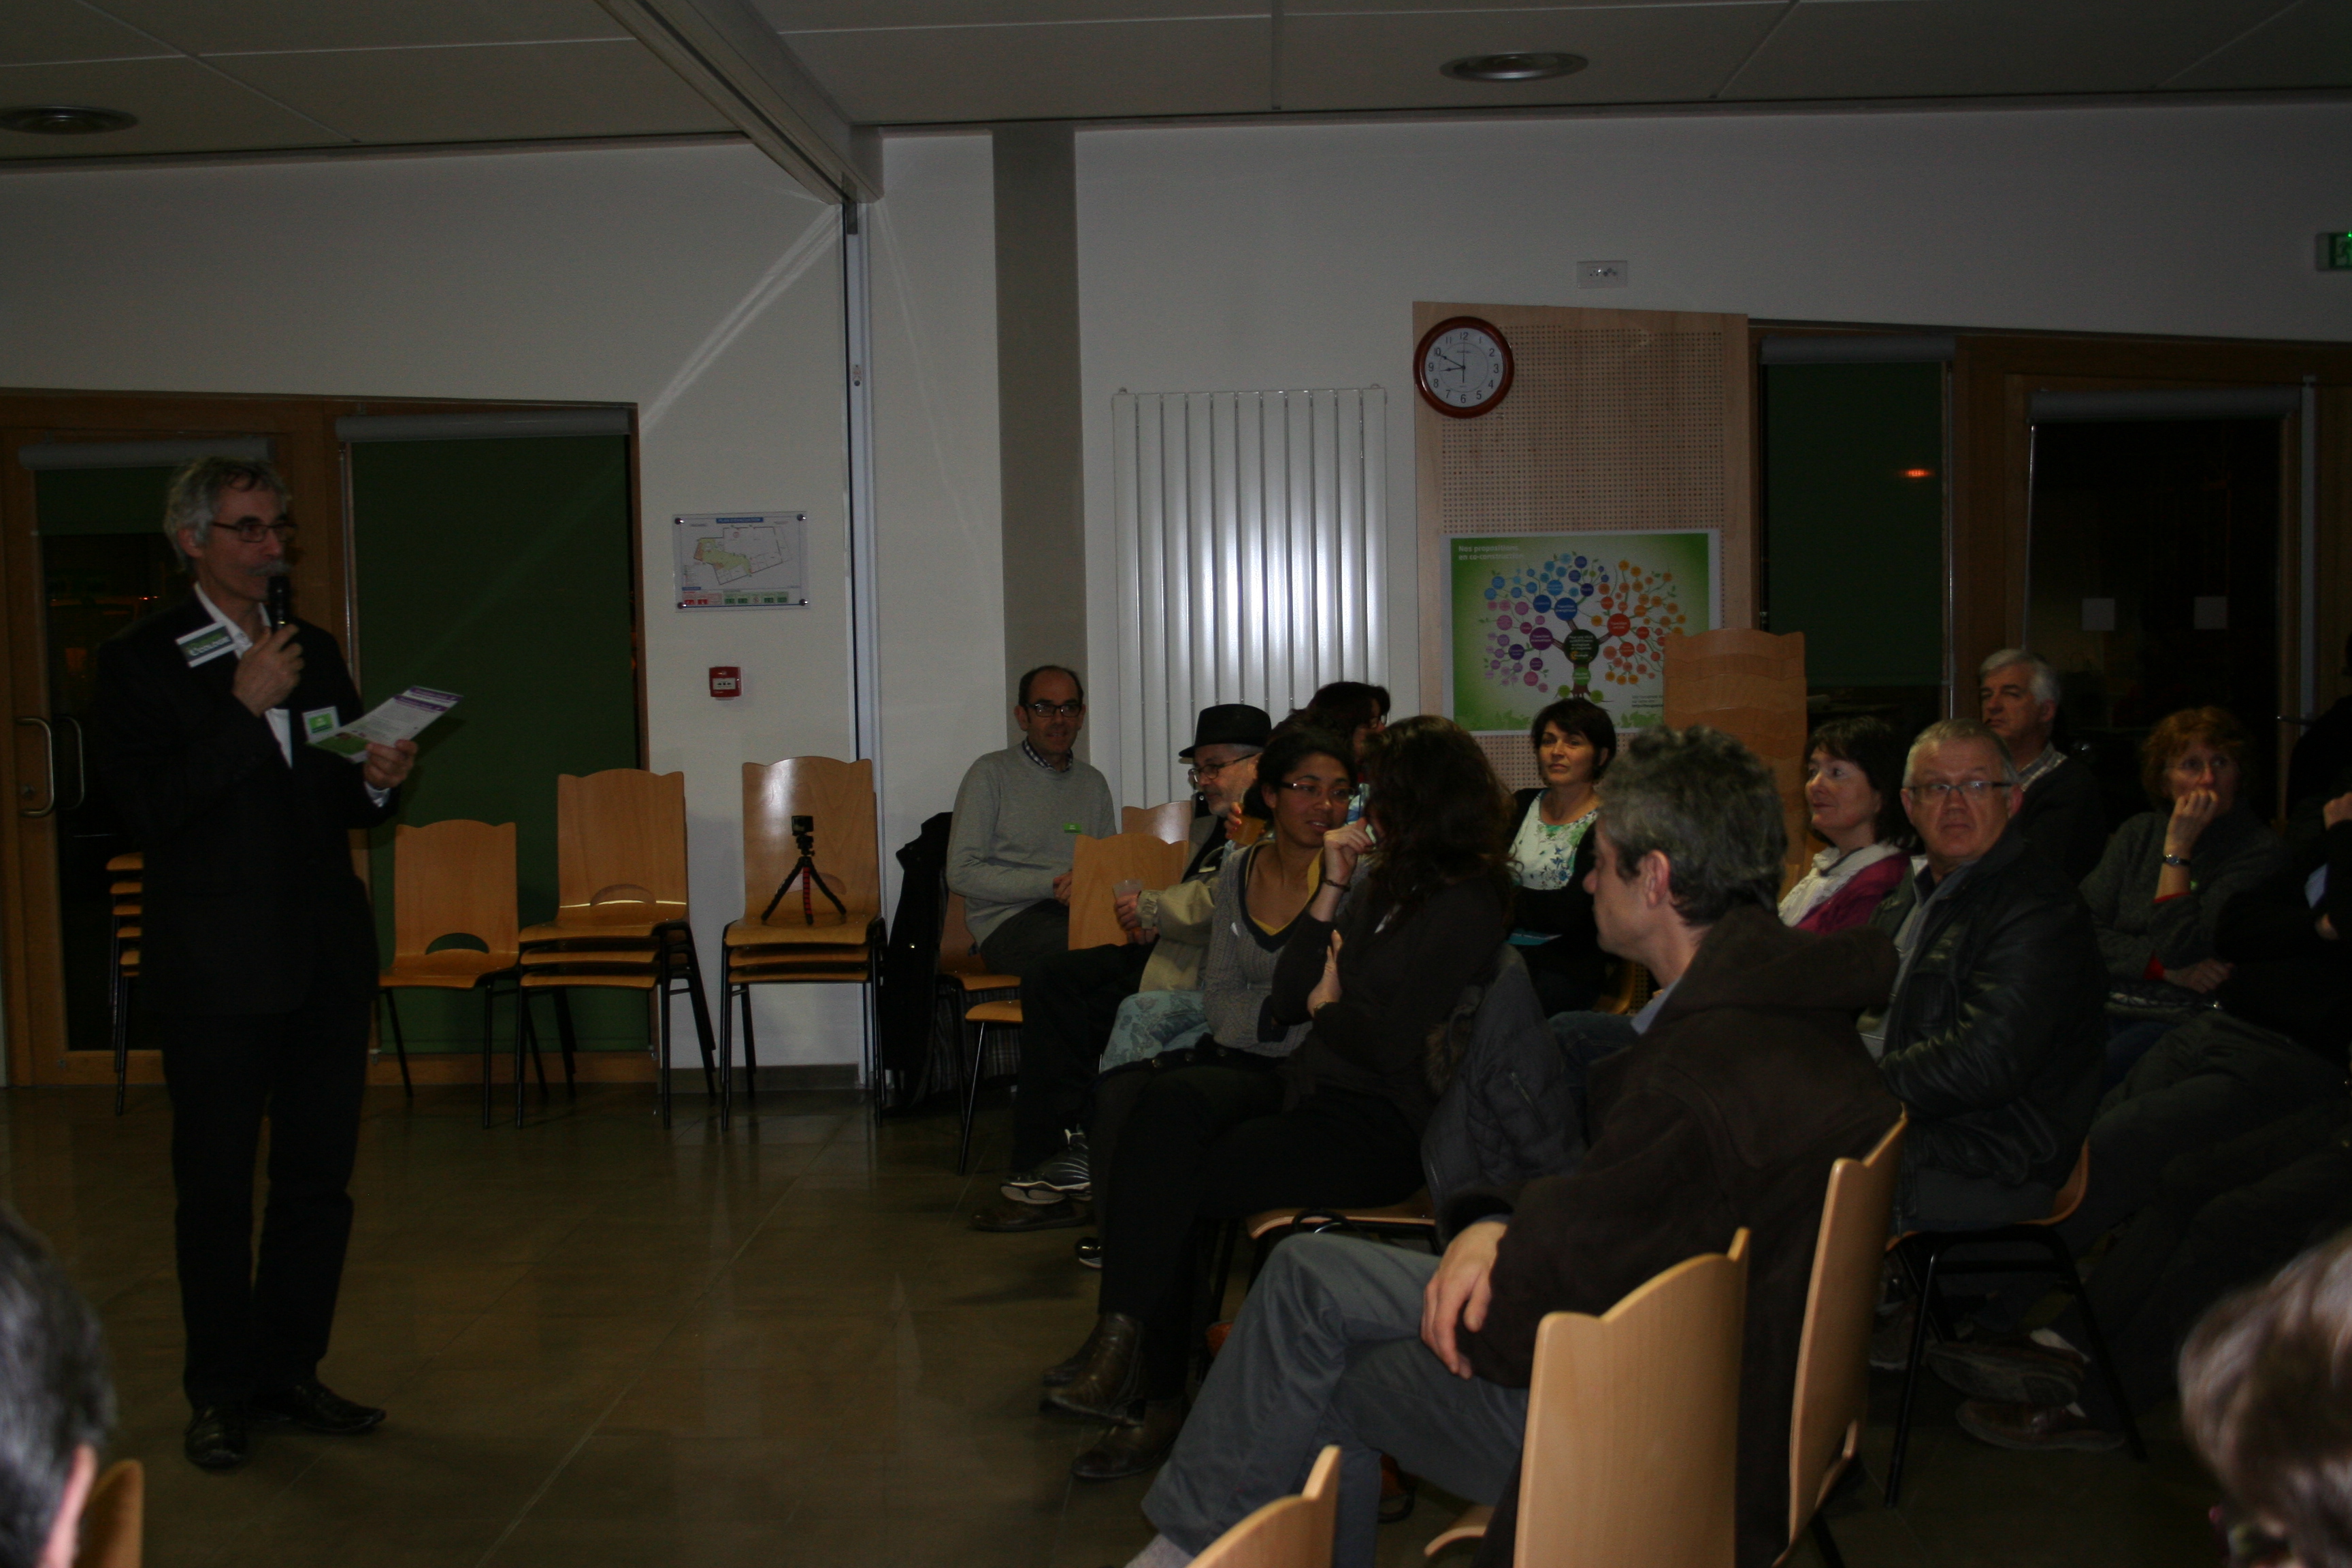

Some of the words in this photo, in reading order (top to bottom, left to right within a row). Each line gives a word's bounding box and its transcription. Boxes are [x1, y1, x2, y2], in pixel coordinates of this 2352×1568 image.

[1459, 331, 1469, 341] 12
[1433, 347, 1441, 357] 10
[1488, 348, 1494, 357] 2
[1428, 362, 1434, 372] 9
[1493, 363, 1499, 374] 3
[1433, 378, 1439, 388] 8
[1488, 379, 1494, 389] 4
[1445, 389, 1451, 399] 7
[1460, 393, 1467, 404] 6
[1475, 390, 1482, 399] 5
